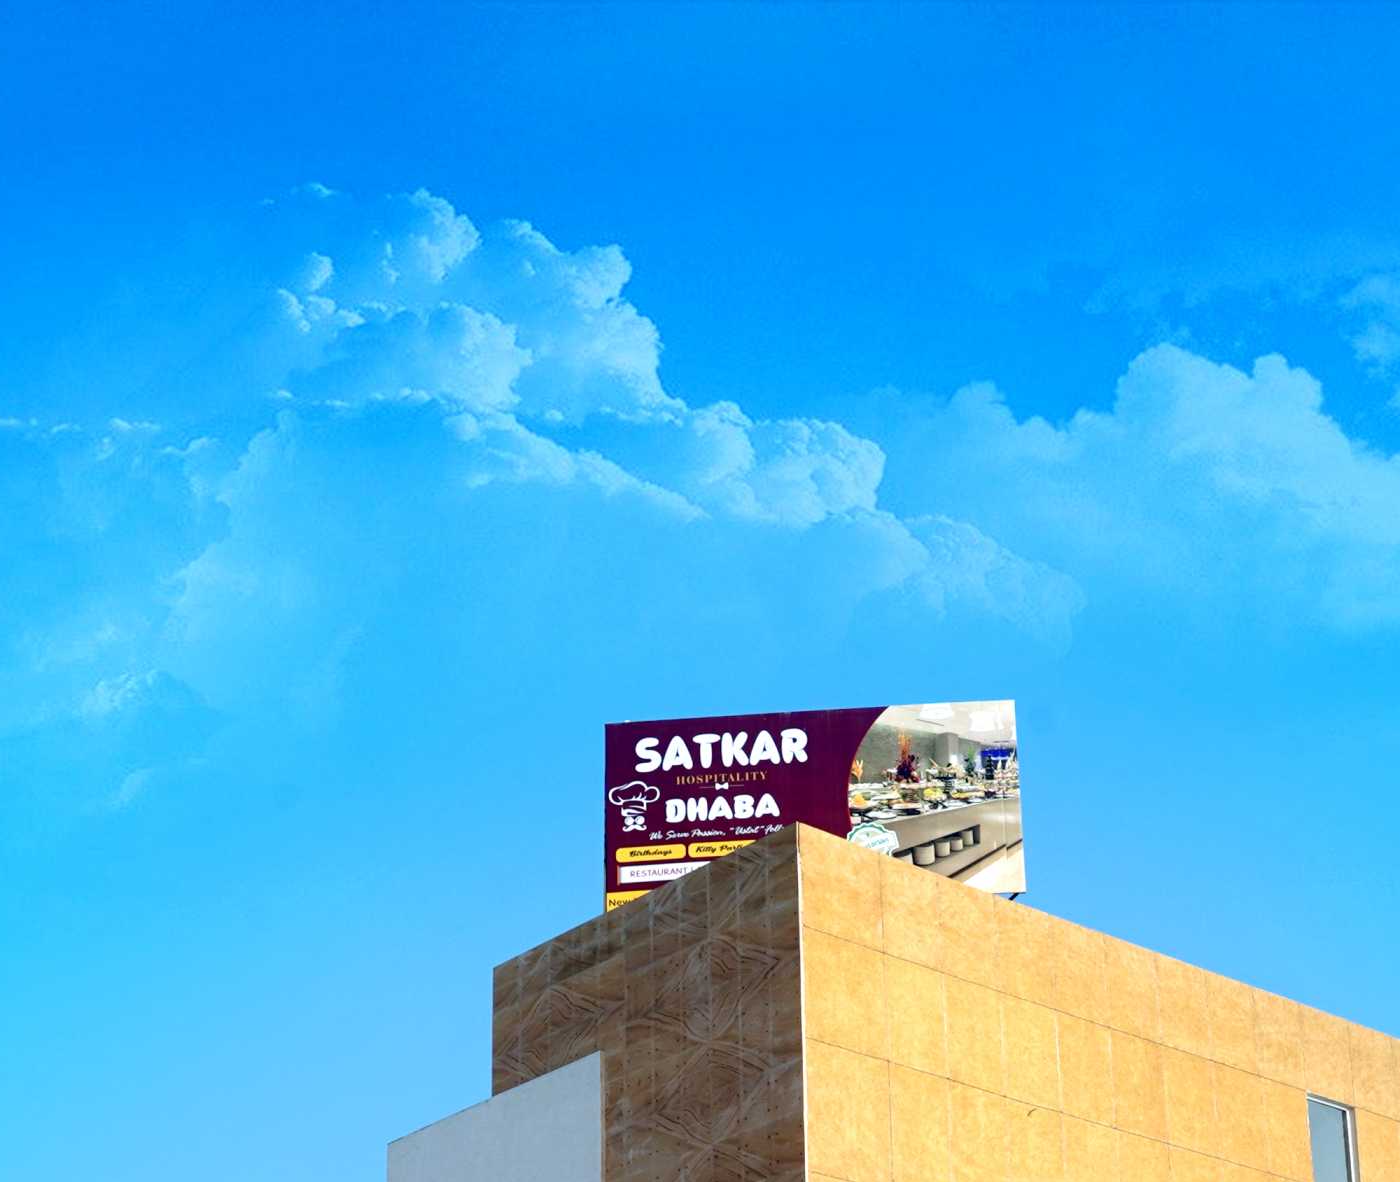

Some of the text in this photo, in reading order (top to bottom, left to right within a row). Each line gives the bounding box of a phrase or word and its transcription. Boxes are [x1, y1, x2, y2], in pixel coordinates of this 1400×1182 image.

[634, 727, 808, 773] SATKAR
[676, 771, 767, 785] HOSPITALITY
[665, 793, 781, 823] DHABA
[629, 849, 673, 857] Birthdays
[696, 846, 716, 854] Kitty
[630, 866, 688, 878] RESTAURANT
